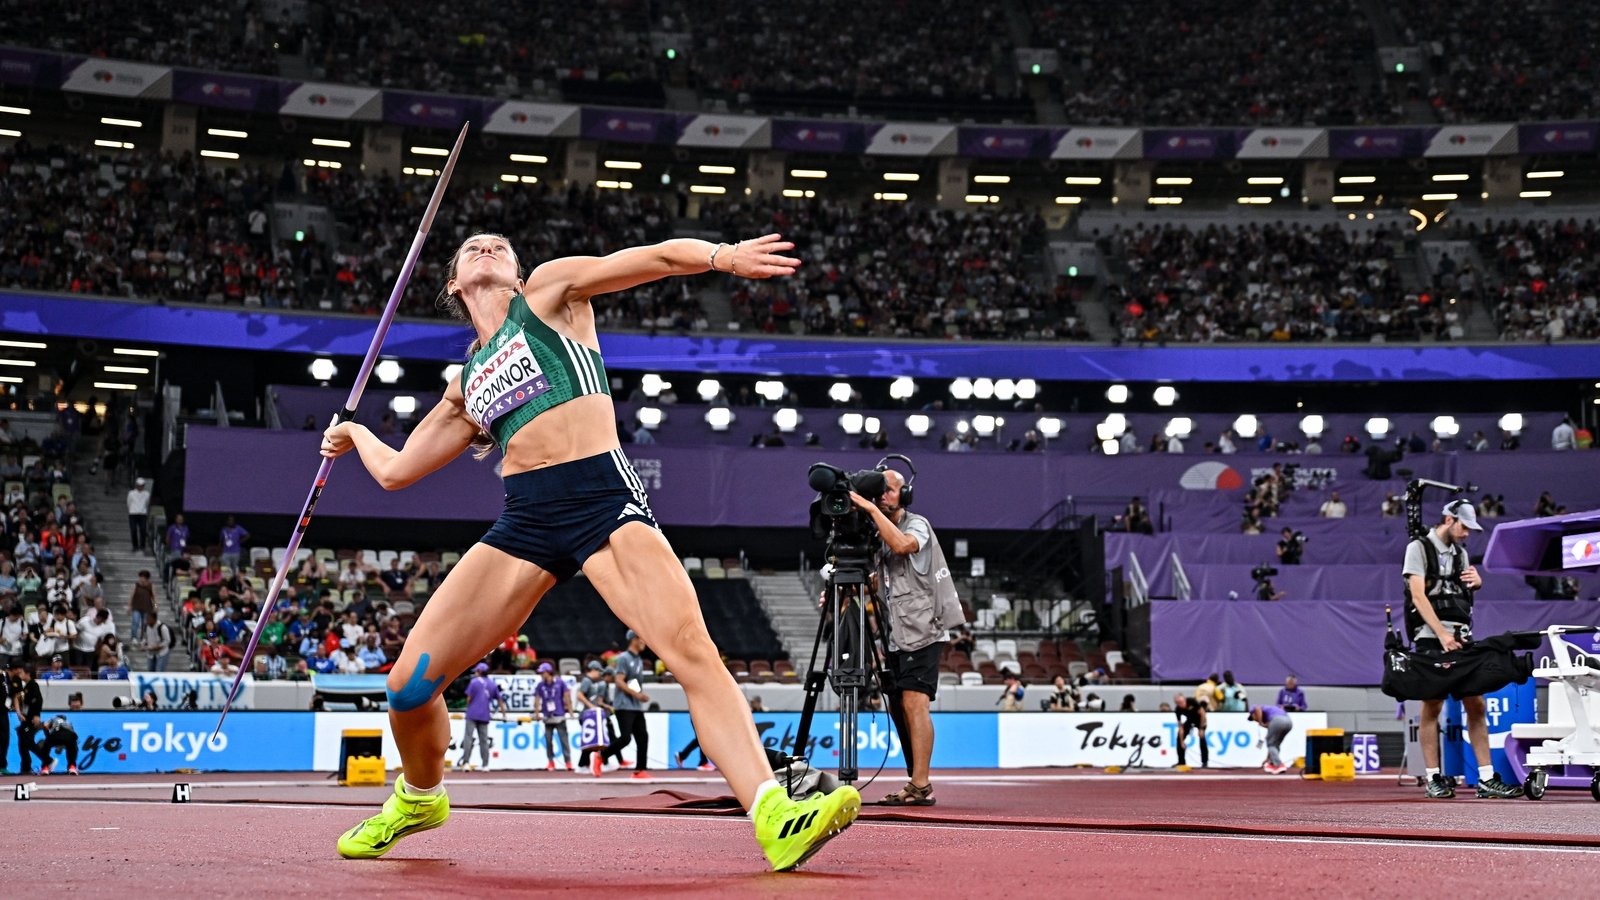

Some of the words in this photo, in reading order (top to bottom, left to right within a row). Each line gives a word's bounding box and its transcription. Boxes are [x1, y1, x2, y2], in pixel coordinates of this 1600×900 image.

[465, 341, 525, 403] HONDA
[122, 722, 228, 761] Tokyo
[1076, 721, 1162, 766] Tokyo
[17, 785, 29, 799] H
[177, 785, 190, 801] H
